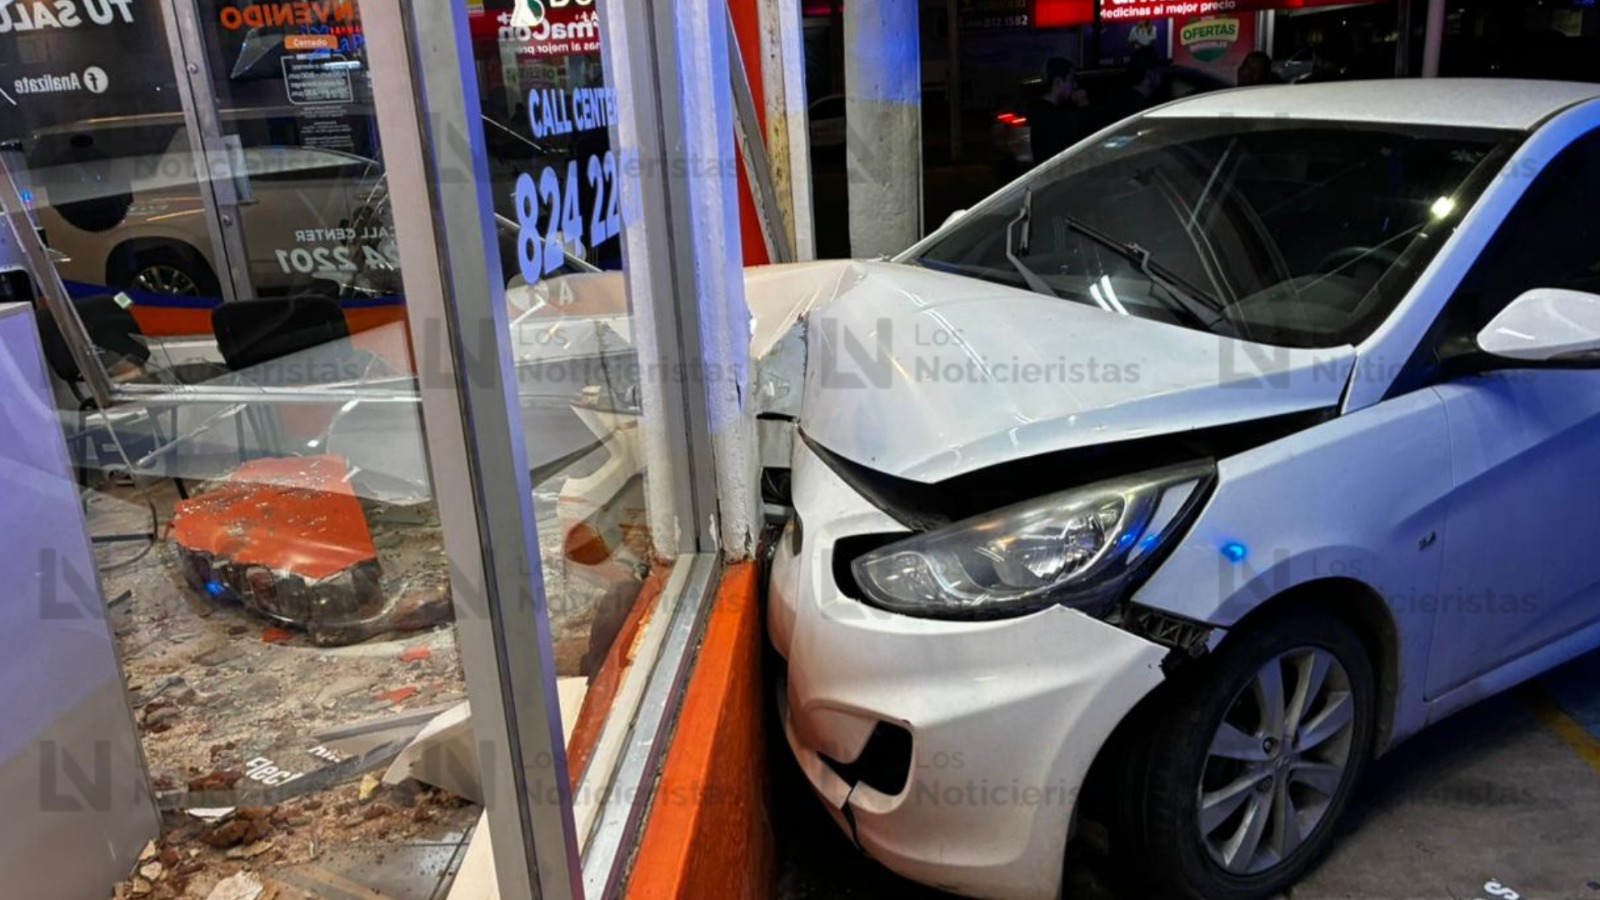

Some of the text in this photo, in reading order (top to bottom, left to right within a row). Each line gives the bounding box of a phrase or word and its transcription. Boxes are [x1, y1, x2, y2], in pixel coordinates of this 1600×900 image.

[1165, 4, 1198, 15] mejor
[1200, 0, 1236, 14] precio
[1183, 24, 1236, 40] OFERTAS
[528, 88, 573, 139] CALL
[514, 159, 585, 286] 824
